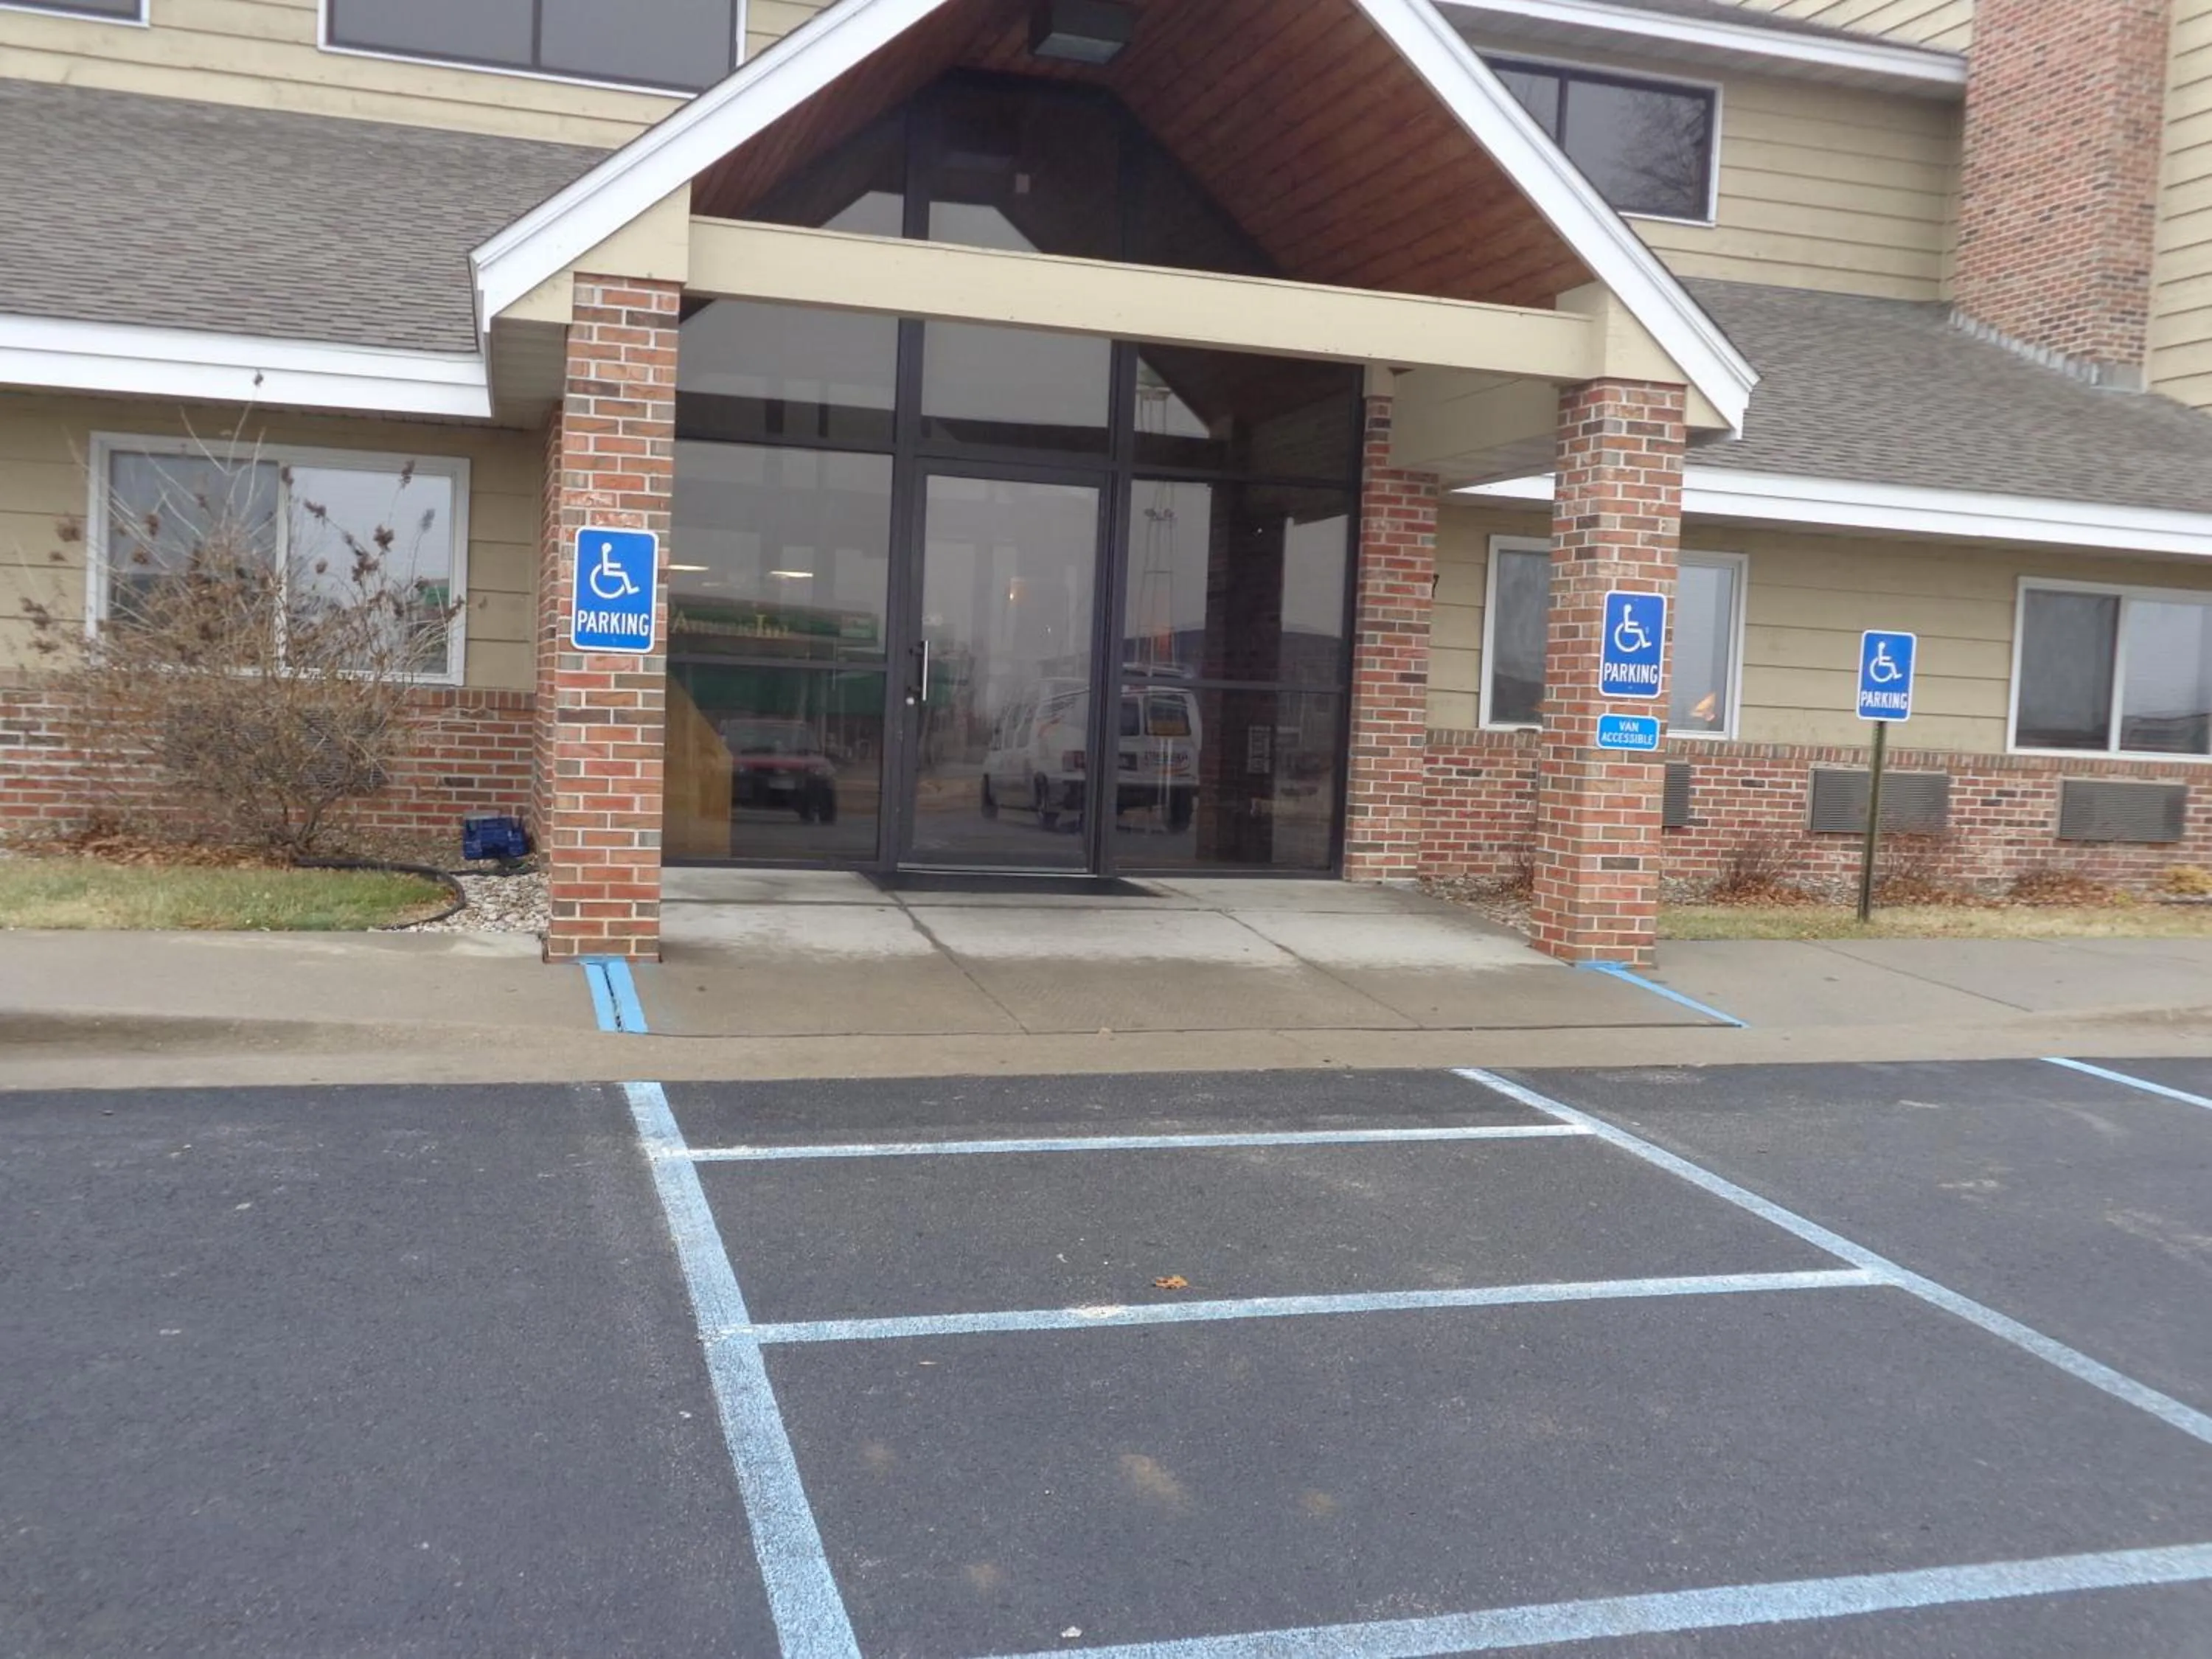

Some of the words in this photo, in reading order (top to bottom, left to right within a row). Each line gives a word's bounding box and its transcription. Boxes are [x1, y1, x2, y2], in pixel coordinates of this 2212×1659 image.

[577, 609, 650, 636] PARKING
[1604, 662, 1658, 684] PARKING
[1860, 690, 1907, 710] PARKING
[1619, 720, 1639, 731] VAN
[1601, 731, 1653, 745] ACCESSIBLE
